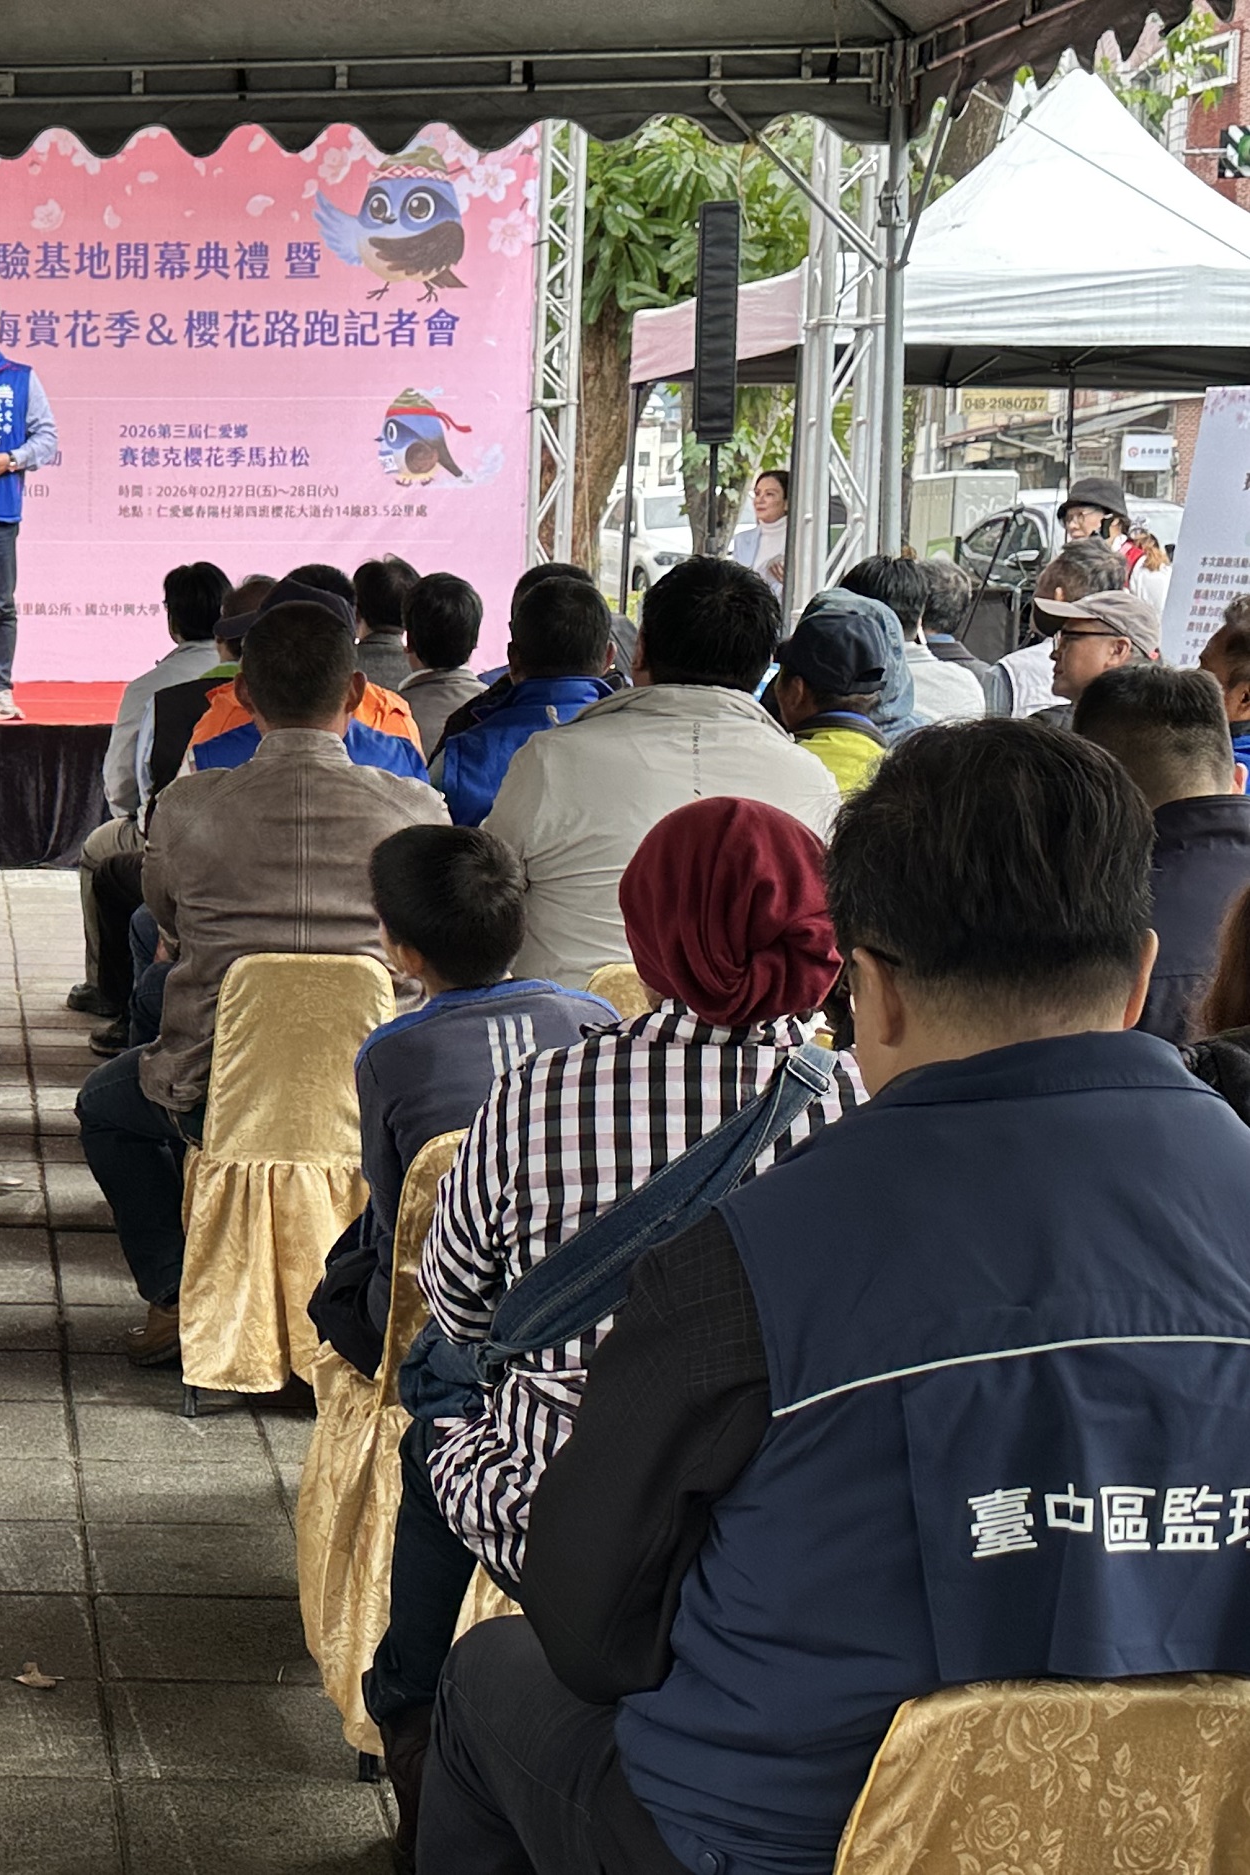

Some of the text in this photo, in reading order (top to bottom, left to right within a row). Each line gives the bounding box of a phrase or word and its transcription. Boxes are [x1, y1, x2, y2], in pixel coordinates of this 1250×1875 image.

[284, 241, 321, 280] 暨
[119, 424, 249, 439] 2026第三屆仁愛鄉
[119, 445, 311, 468] 賽德克櫻花季馬拉松
